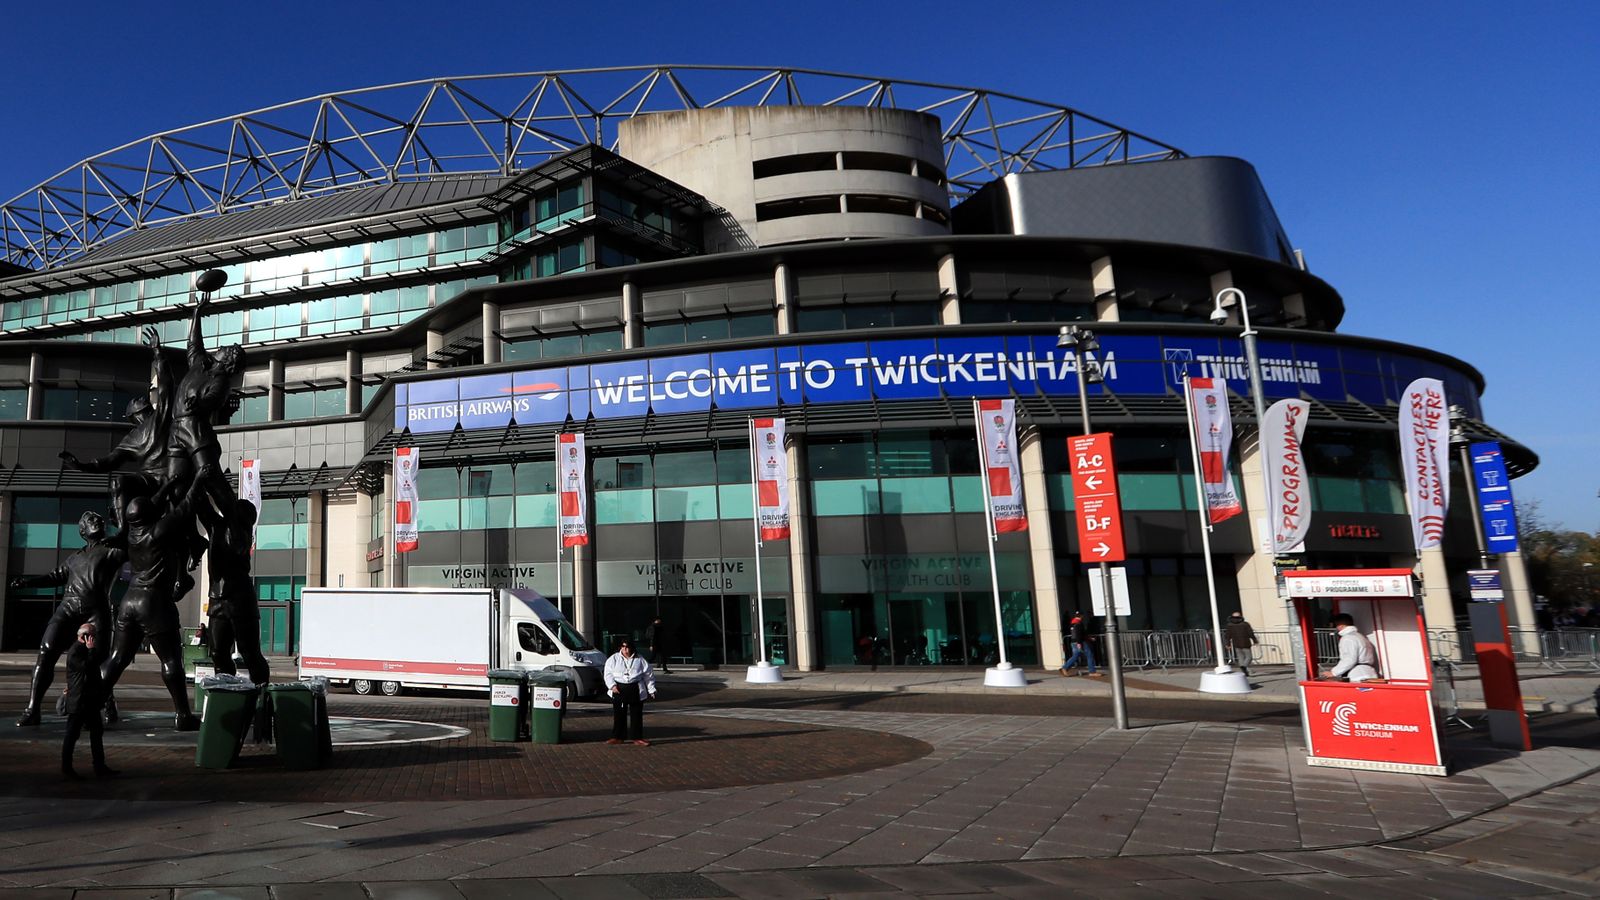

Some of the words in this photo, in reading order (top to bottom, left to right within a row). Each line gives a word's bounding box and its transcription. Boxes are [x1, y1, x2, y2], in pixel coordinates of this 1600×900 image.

[1196, 354, 1321, 385] TWICENHAM
[594, 363, 770, 405] WELCOME
[780, 360, 835, 390] TO
[845, 350, 1118, 386] TWICKENHAM
[408, 400, 464, 421] BRITISH
[467, 397, 530, 416] AIRWAYS
[1425, 387, 1442, 431] HERE
[1410, 391, 1430, 501] CONTACTLESS
[1077, 454, 1104, 469] A-C
[1282, 404, 1302, 530] PROGRAMMES
[762, 513, 788, 521] DRIVING
[1086, 516, 1111, 531] D-F
[635, 563, 687, 576] VIRGIN
[693, 562, 745, 574] ACTIVE
[862, 558, 920, 571] VIRGIN
[928, 556, 982, 569] ACTIVE
[442, 567, 487, 579] VIRGIN
[491, 566, 535, 578] ACTIVE
[647, 579, 695, 591] HEALTH
[700, 578, 733, 590] CLUB
[1353, 721, 1419, 733] TWICKENHAM
[1354, 730, 1393, 739] STADIUM
